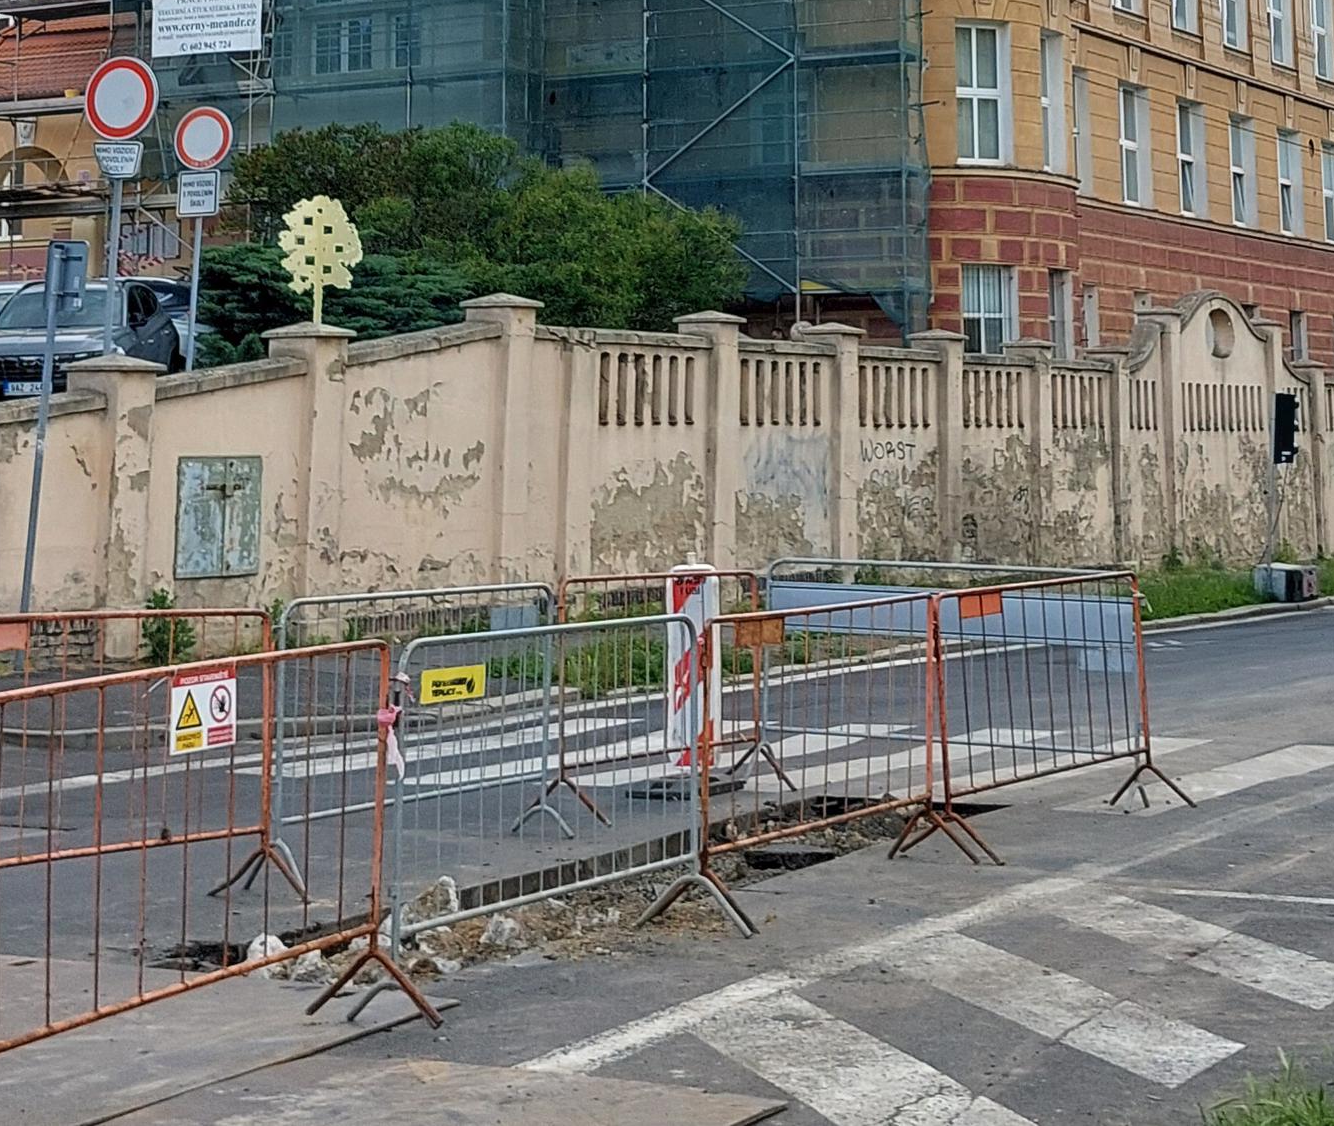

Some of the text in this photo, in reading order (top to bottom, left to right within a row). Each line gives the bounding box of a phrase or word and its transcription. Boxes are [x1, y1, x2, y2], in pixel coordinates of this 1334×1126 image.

[157, 18, 256, 33] www.cerny-meandr.cz
[219, 41, 231, 49] 724
[860, 439, 916, 462] WORST
